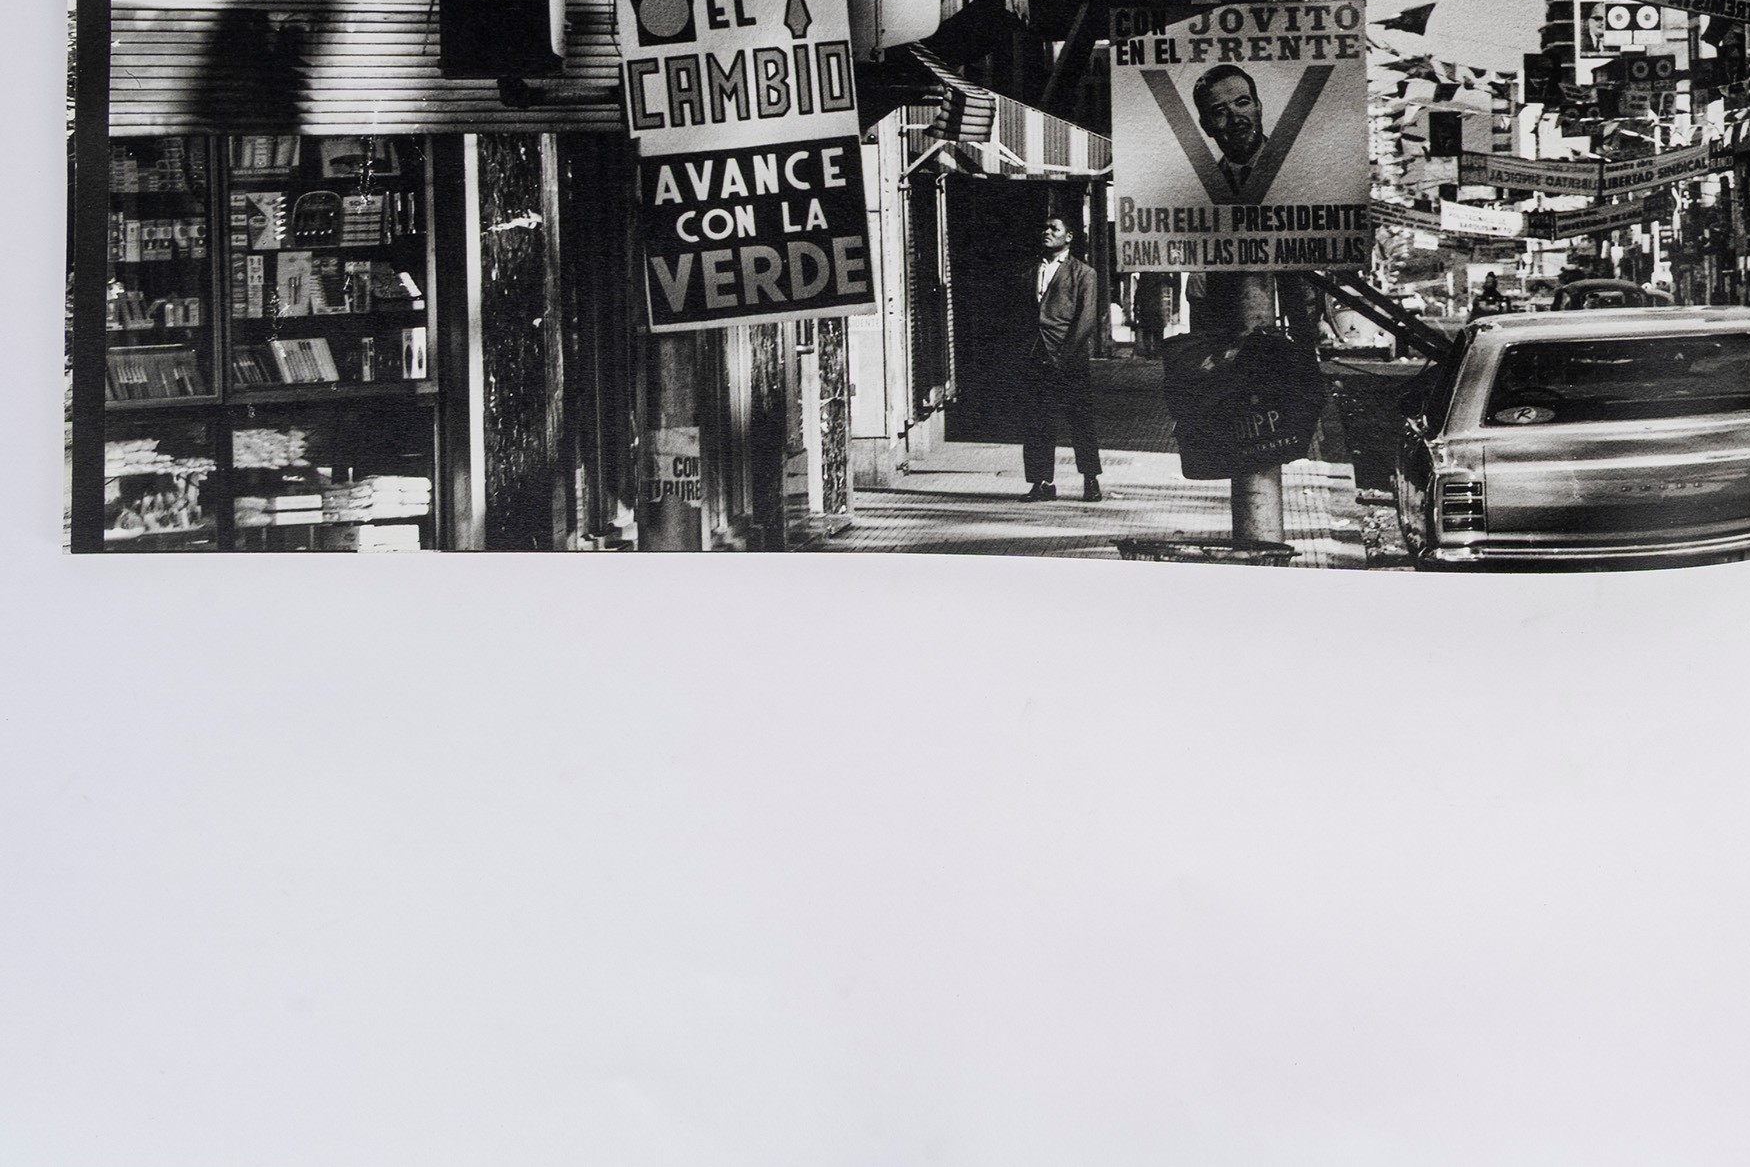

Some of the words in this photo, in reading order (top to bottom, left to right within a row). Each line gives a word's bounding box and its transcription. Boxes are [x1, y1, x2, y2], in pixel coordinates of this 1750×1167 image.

[1115, 8, 1167, 36] CON
[1189, 3, 1361, 35] JOVITO
[1116, 39, 1145, 66] EN
[1155, 38, 1182, 65] EL
[1189, 34, 1362, 63] FRENTE
[627, 40, 855, 131] CAMBIO
[654, 147, 847, 205] AVANCE
[1657, 156, 1708, 179] SINDICAL
[676, 204, 756, 242] CON
[782, 198, 828, 234] LA
[1232, 204, 1368, 233] PRESIDENTE
[1122, 241, 1161, 266] GANA
[1166, 240, 1198, 266] CON
[1203, 239, 1234, 265] LAS
[1238, 239, 1270, 265] DOS
[1274, 238, 1365, 265] AMARILLAS
[651, 235, 867, 313] VERDE
[1516, 407, 1533, 420] R
